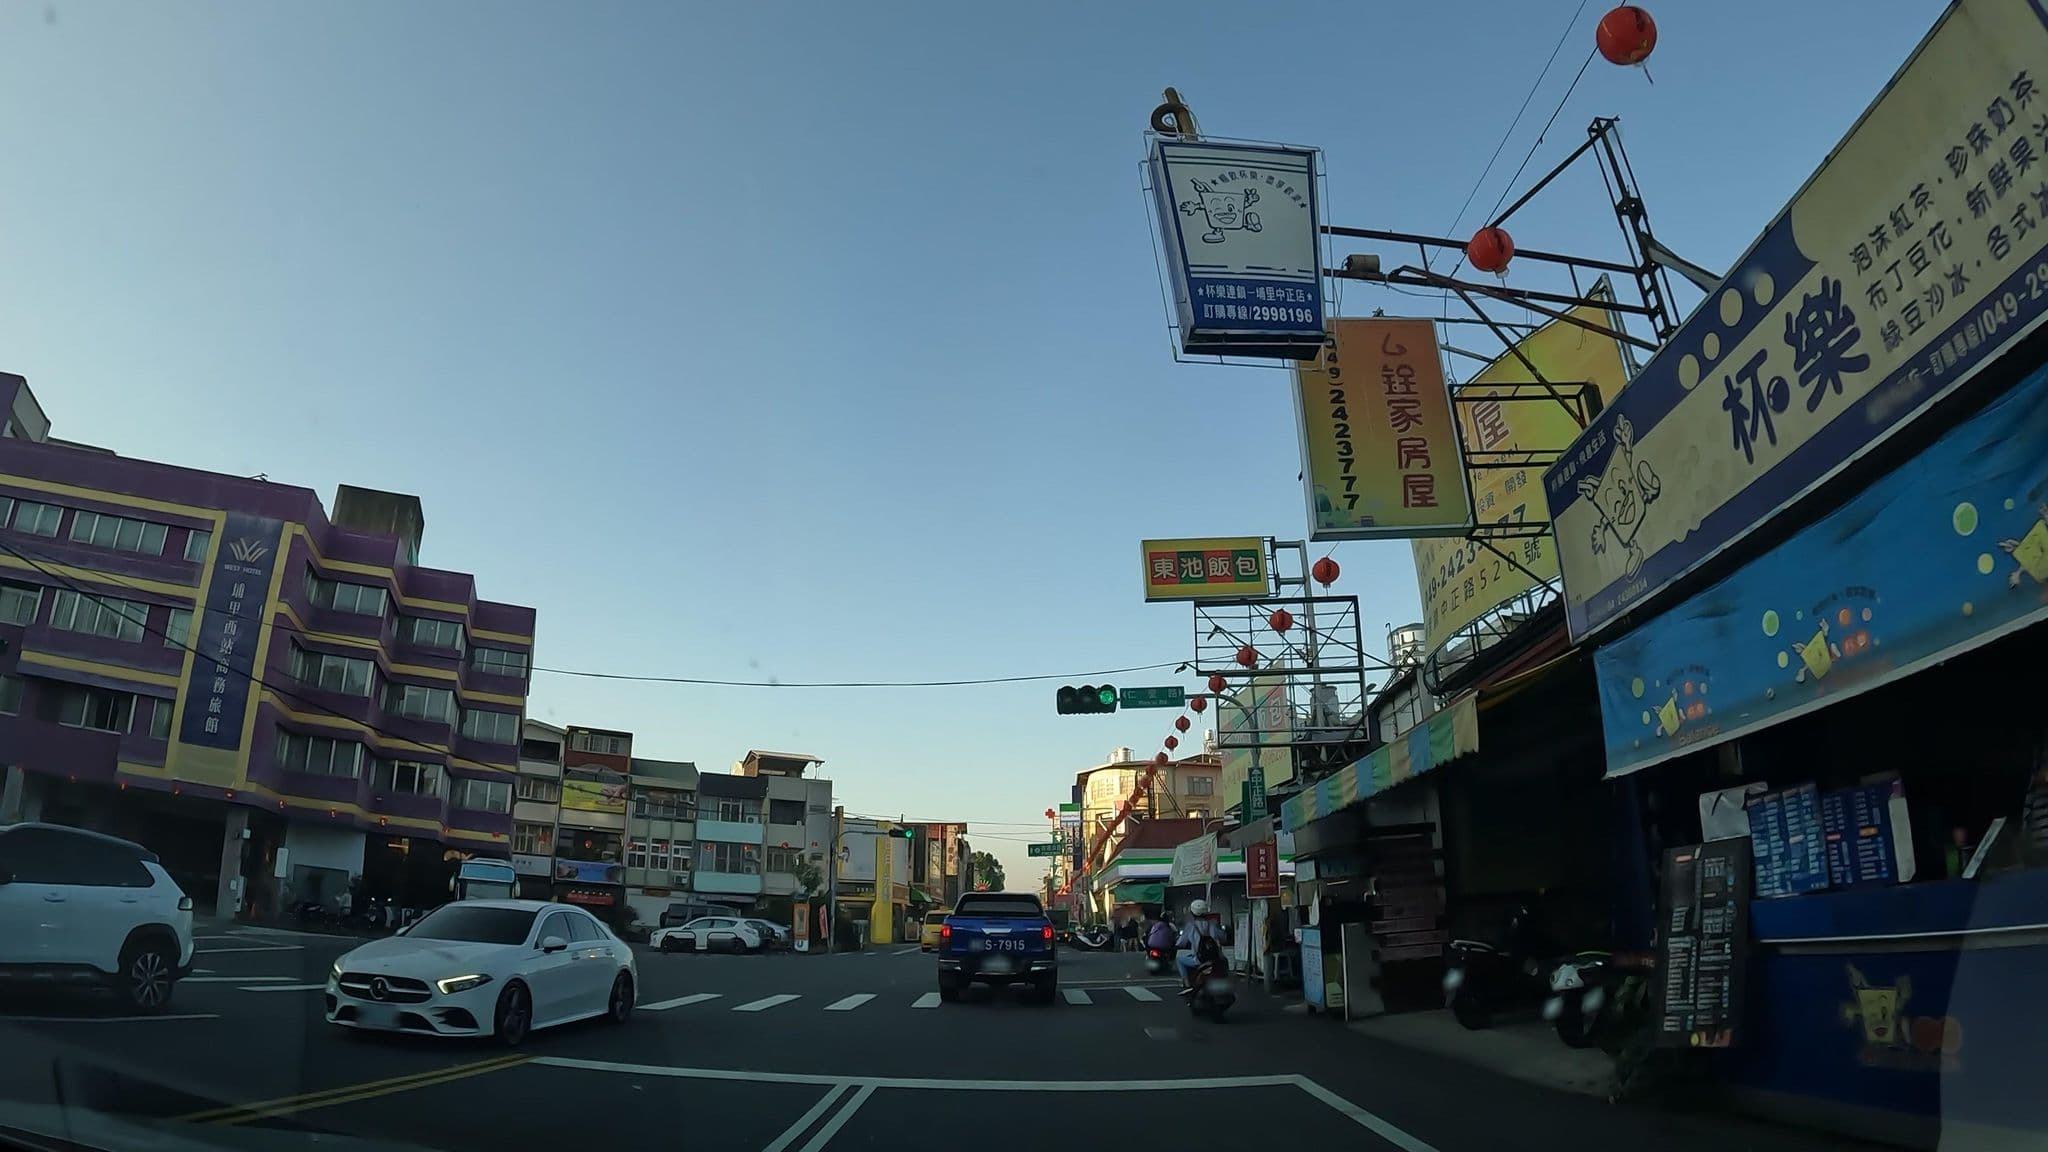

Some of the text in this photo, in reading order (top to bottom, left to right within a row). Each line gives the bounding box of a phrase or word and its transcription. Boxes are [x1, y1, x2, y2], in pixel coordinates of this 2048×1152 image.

[1722, 275, 1870, 465] 杯樂
[1151, 555, 1259, 580] 東池飯包
[1250, 774, 1266, 809] 中正路
